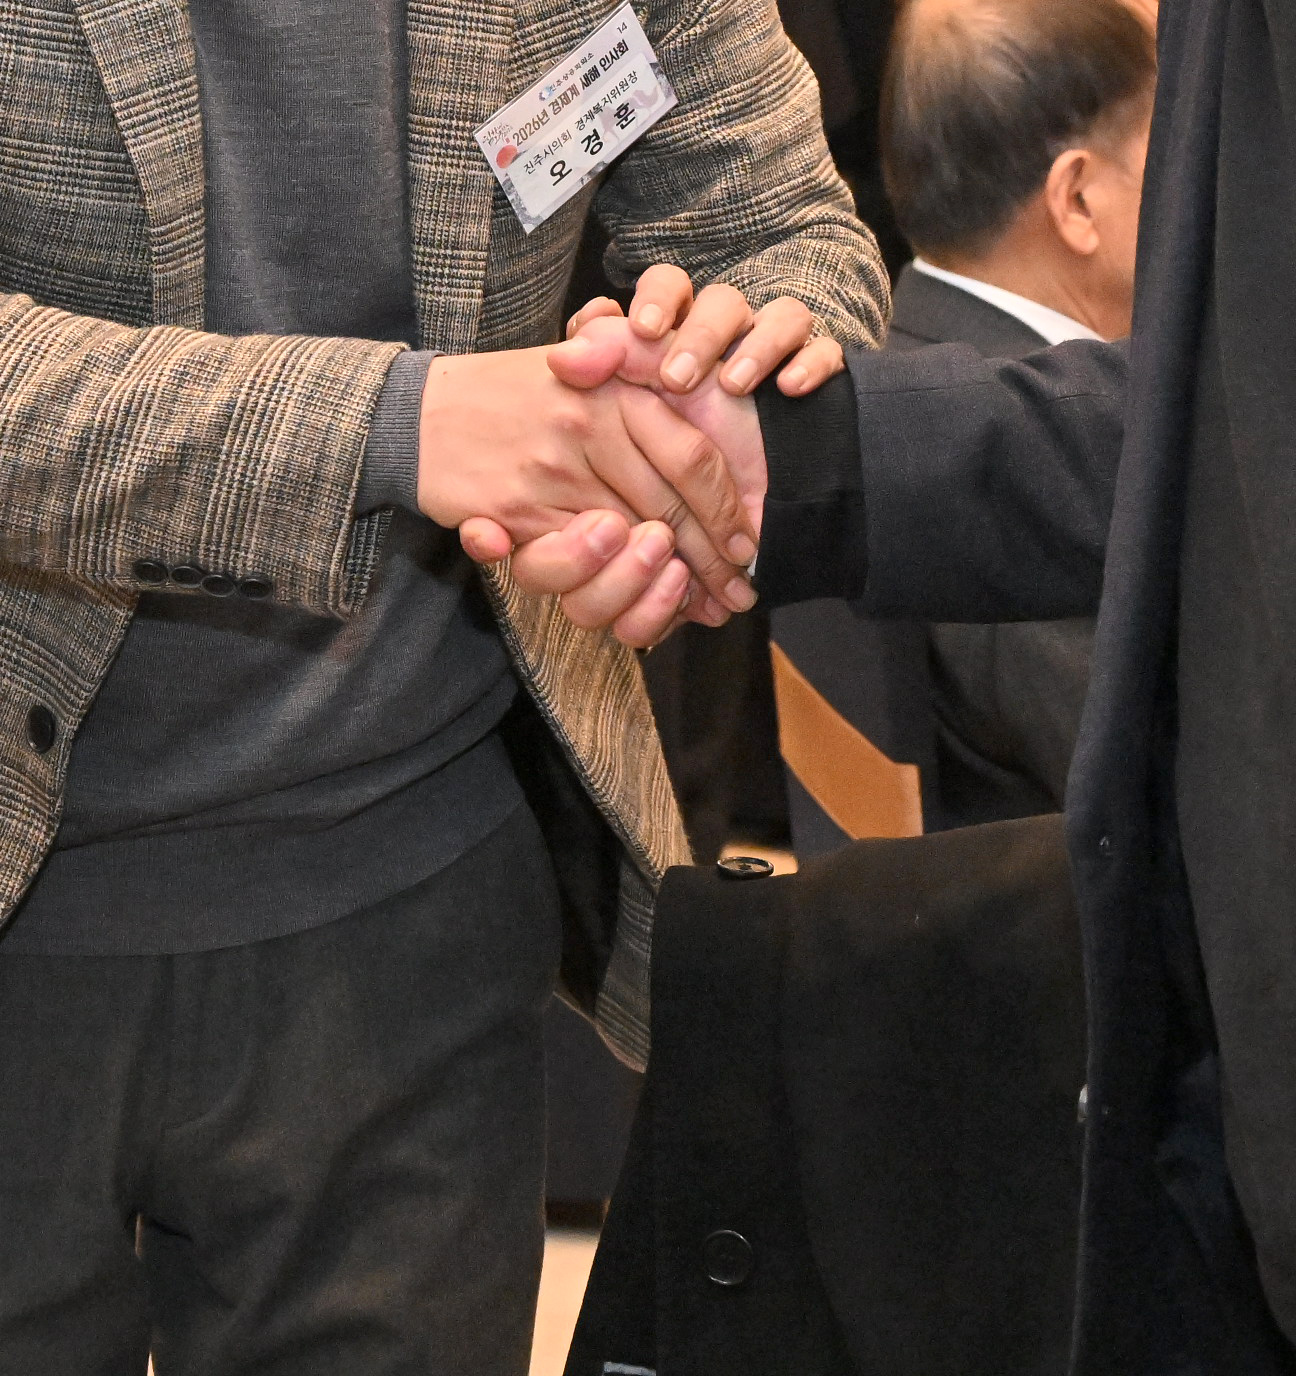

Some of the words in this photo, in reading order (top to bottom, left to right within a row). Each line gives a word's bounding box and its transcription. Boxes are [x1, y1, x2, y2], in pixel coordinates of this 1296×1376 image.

[616, 21, 628, 34] 14
[512, 109, 551, 147] 2026년
[548, 83, 580, 116] 경제계
[581, 65, 601, 91] 새해
[599, 39, 630, 72] 인사회
[523, 129, 573, 176] 진주시의회
[574, 70, 639, 131] 경제복지위원장
